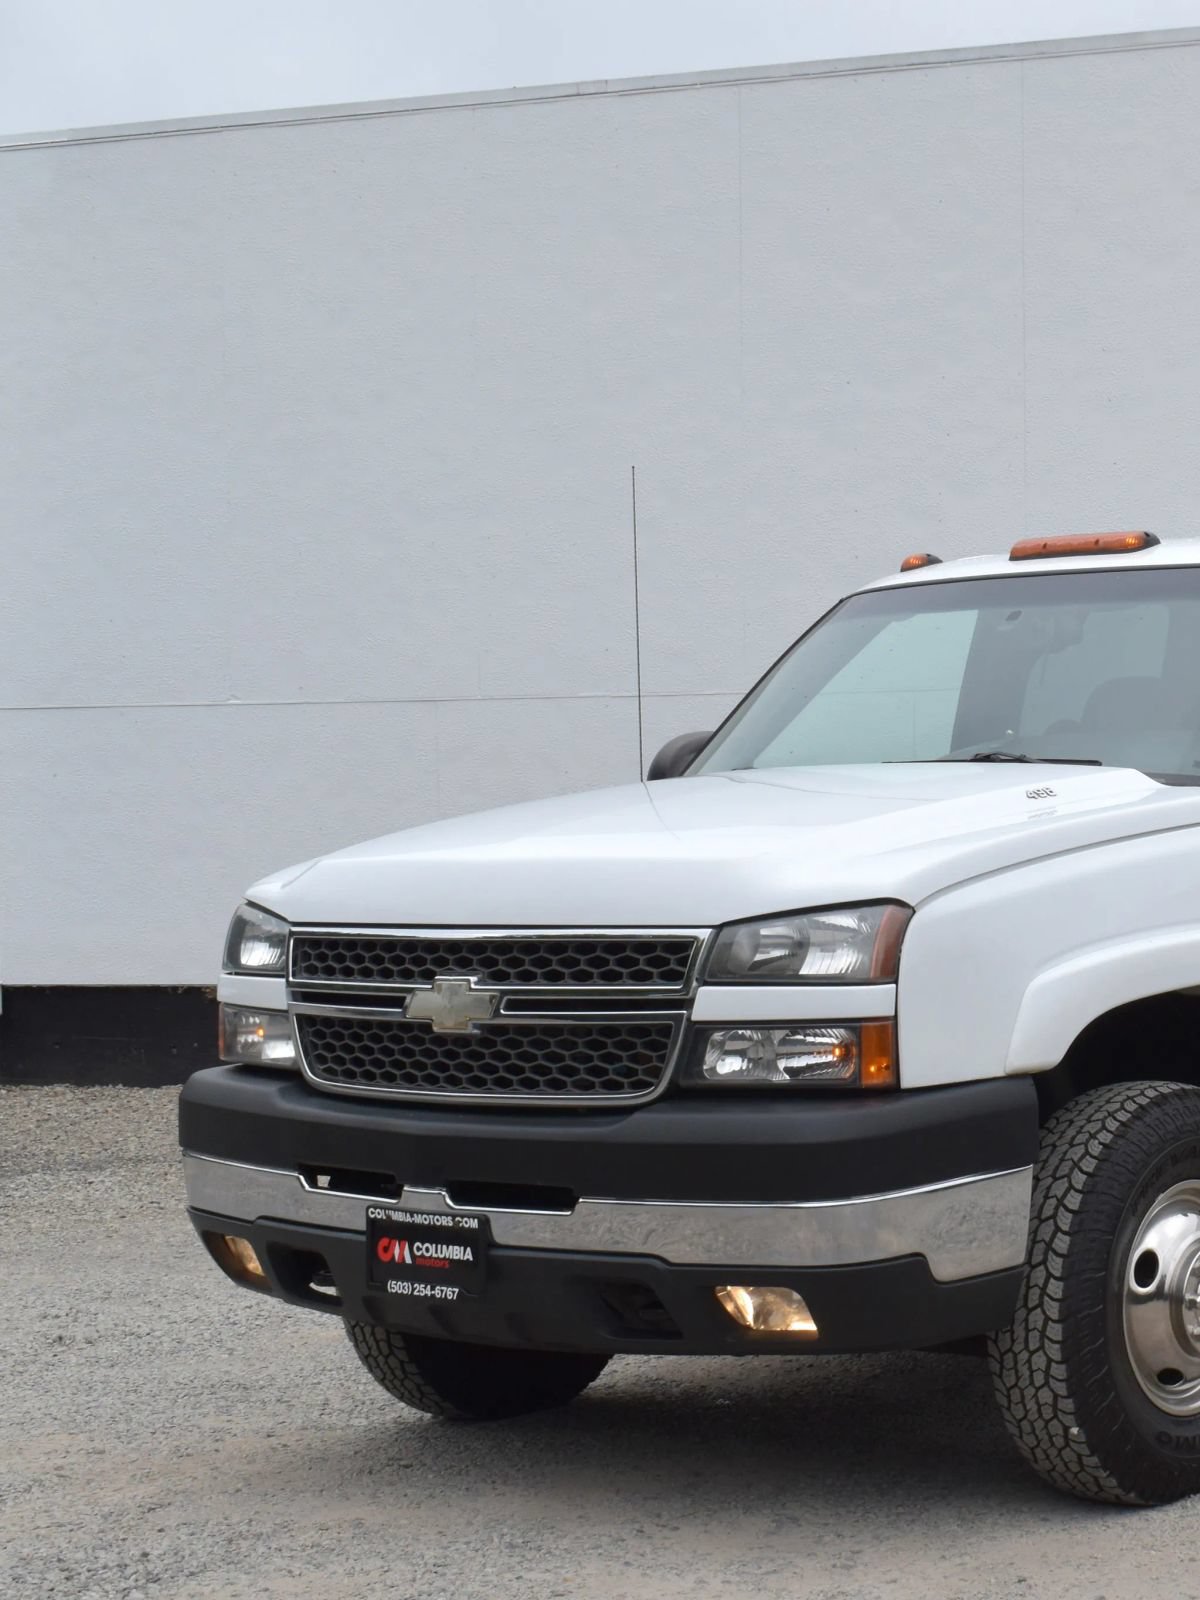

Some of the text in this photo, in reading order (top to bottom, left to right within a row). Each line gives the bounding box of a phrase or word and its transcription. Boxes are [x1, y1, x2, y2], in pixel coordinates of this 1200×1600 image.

[368, 1207, 479, 1229] COLMBIA-MOTORSCOM
[413, 1241, 473, 1261] COLUMBIA
[387, 1279, 459, 1300] (503) 254-6767
